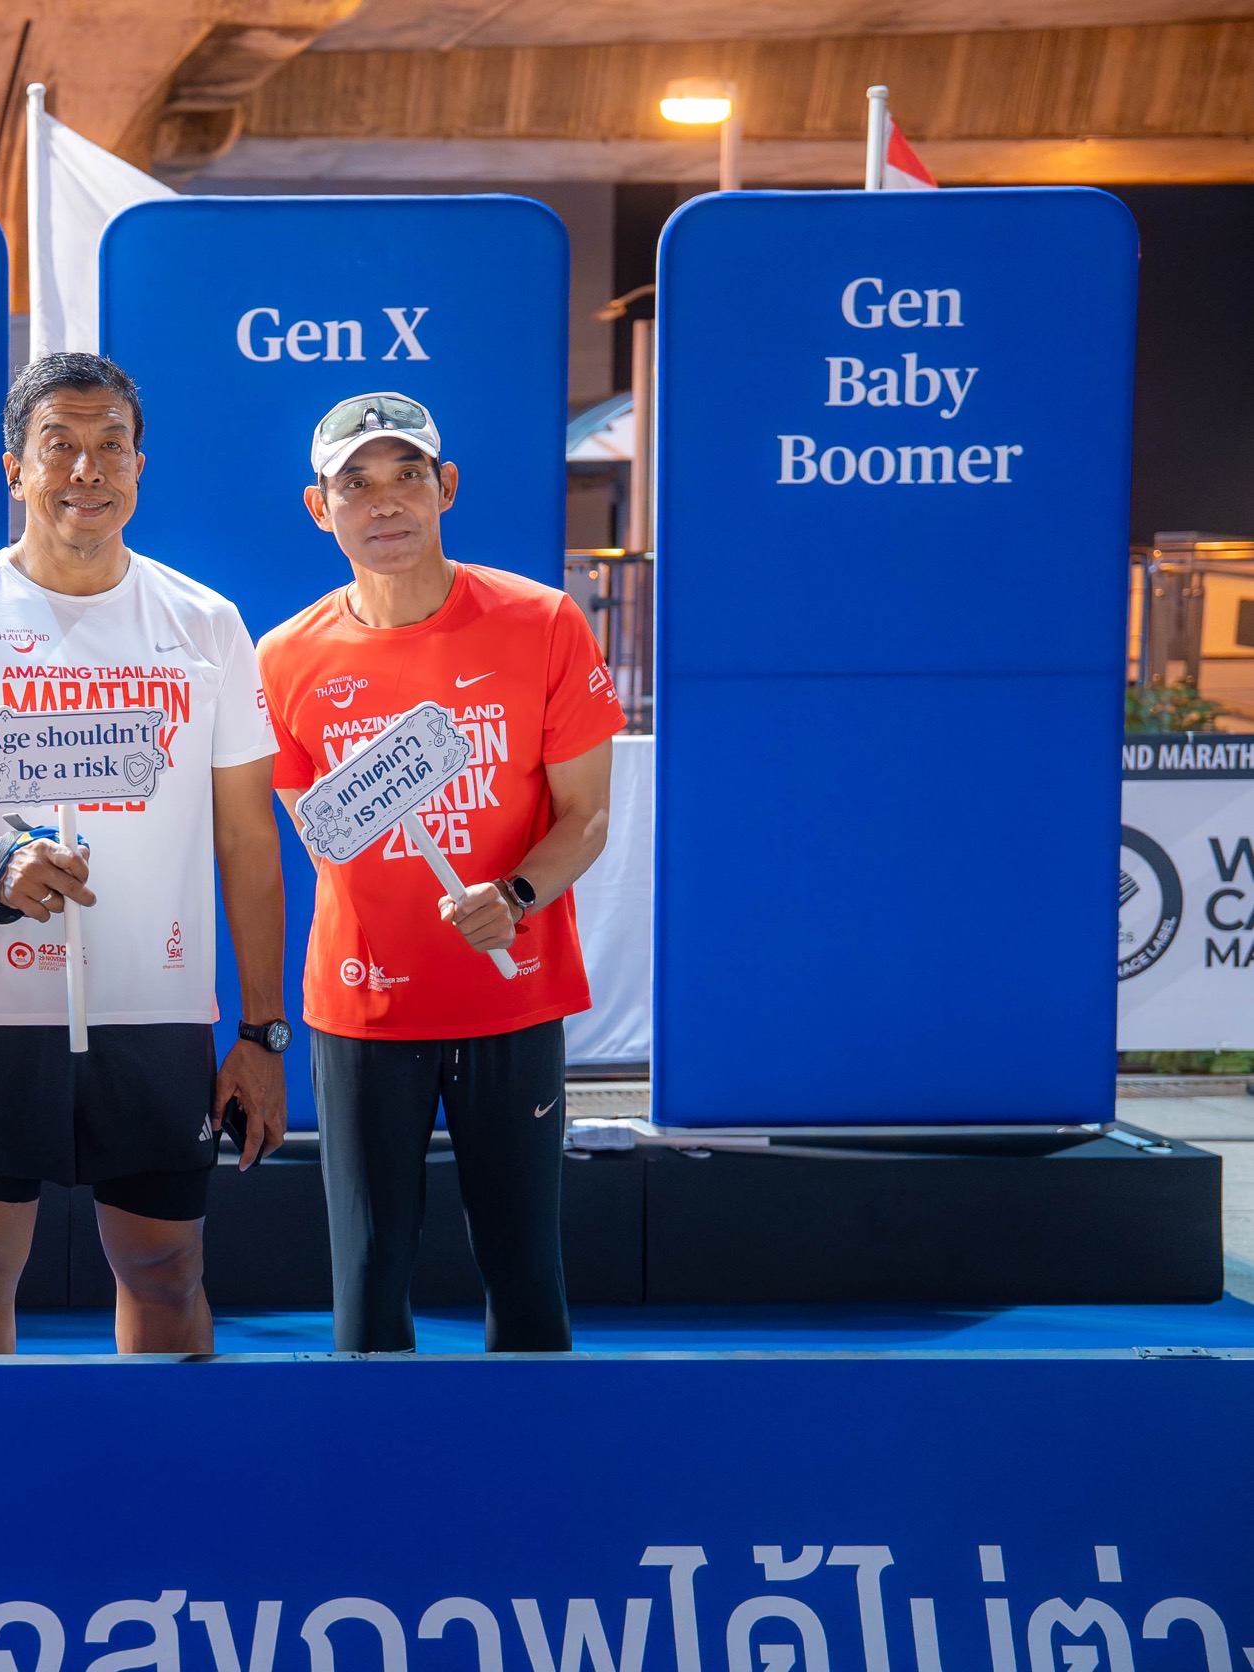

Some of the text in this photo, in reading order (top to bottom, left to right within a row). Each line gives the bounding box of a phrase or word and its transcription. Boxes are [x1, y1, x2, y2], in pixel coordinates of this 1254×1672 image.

[841, 277, 964, 329] Gen
[237, 307, 430, 362] Gen X
[824, 352, 979, 419] Baby
[776, 435, 1023, 485] Boomer
[2, 665, 187, 680] AMAZING THAILAND
[314, 678, 369, 698] THAILAND
[327, 674, 353, 686] amazing
[36, 722, 150, 748] shouldn’t
[17, 755, 119, 781] be a risk
[337, 735, 422, 807] แก่แต่เก๋า
[353, 753, 434, 828] เราทำได้
